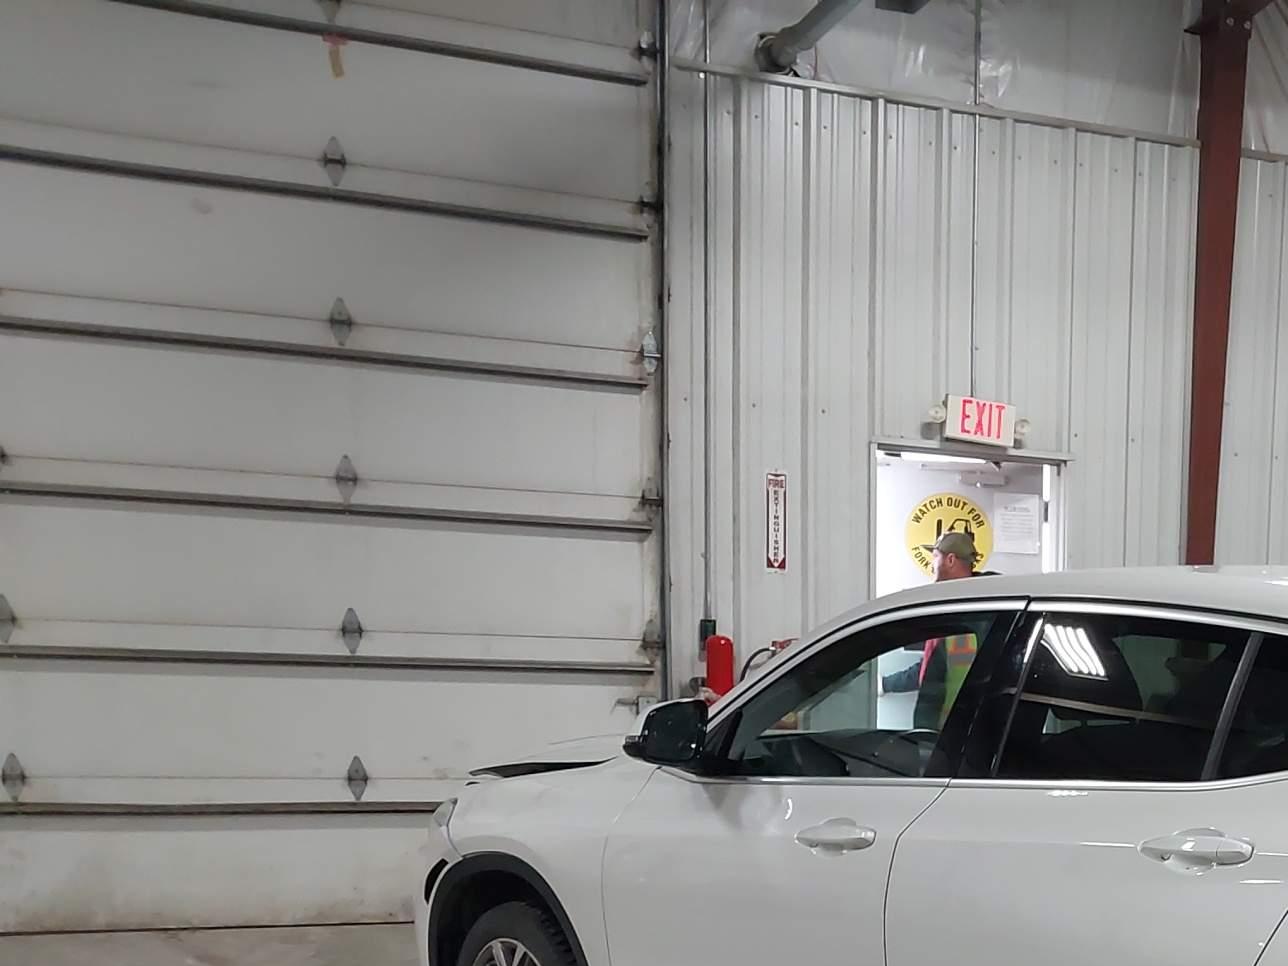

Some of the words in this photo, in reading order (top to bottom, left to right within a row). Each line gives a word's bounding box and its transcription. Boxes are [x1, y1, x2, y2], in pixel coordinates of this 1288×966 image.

[960, 398, 1006, 440] EXIT
[768, 479, 784, 488] FIRE
[911, 497, 943, 524] WATCH
[946, 497, 968, 511] OUT
[967, 508, 985, 528] FOR
